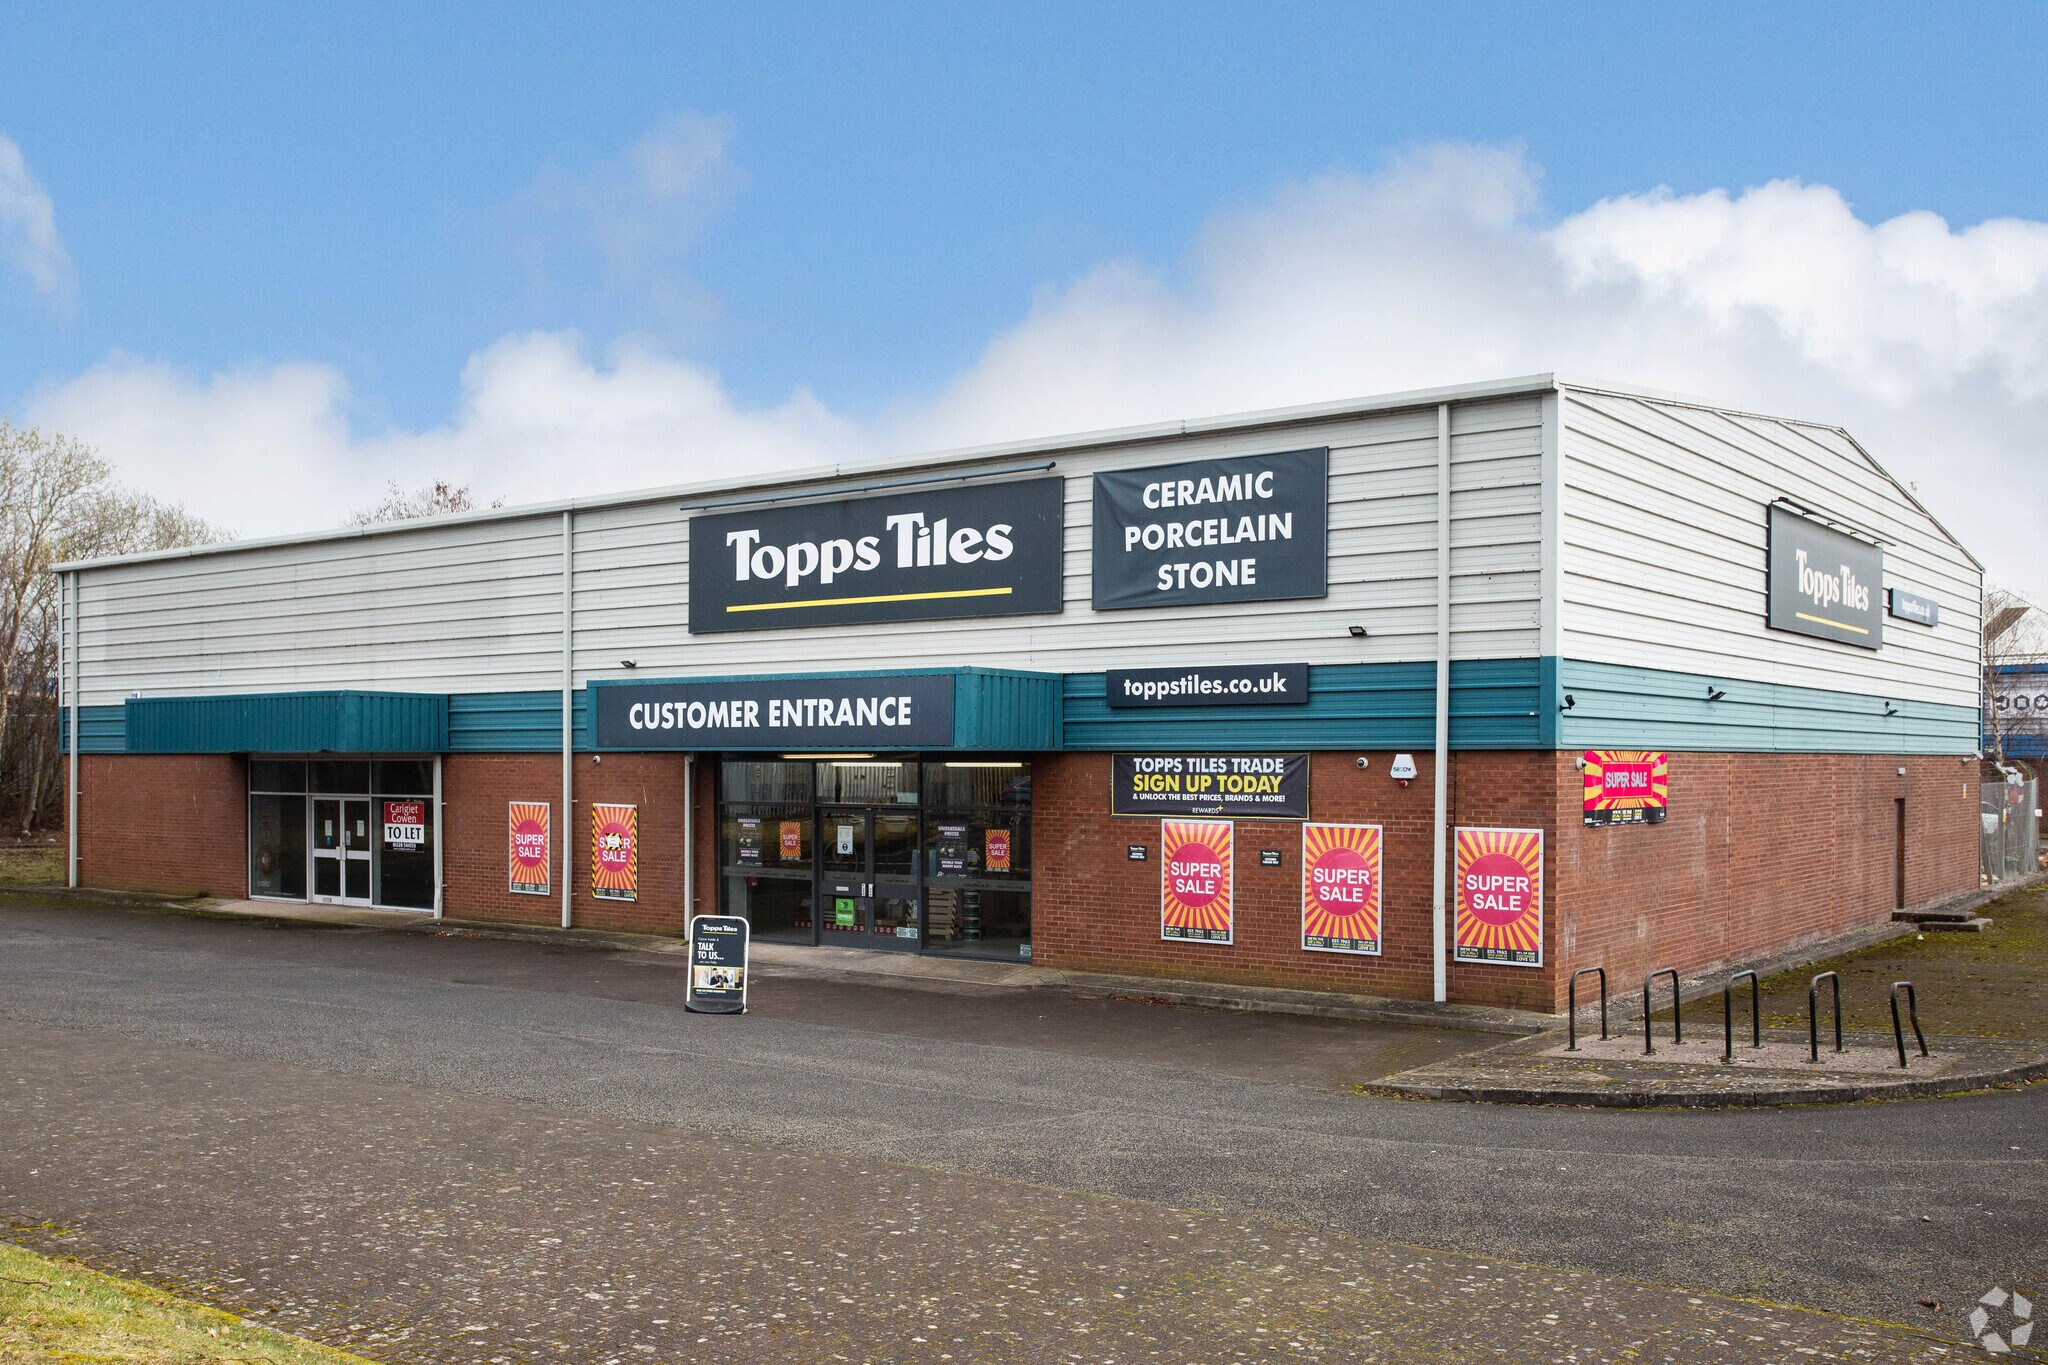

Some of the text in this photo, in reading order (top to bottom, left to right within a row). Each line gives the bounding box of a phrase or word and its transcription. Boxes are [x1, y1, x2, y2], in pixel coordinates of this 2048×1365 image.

[1142, 471, 1273, 509] CERAMIC
[1125, 512, 1292, 552] PORCELAIN
[726, 512, 1014, 587] Topps Tiles
[1157, 558, 1256, 591] STONE
[1796, 548, 1869, 611] Topps Tiles
[1124, 672, 1287, 700] toppstiles.co.uk
[629, 696, 912, 730] CUSTOMER ENTRANCE
[1133, 758, 1284, 773] TOPPS TILES TRADE
[1133, 775, 1283, 793] SIGN UP TODAY
[1606, 771, 1647, 788] SUPER SALE
[1139, 793, 1167, 801] UNLOCK
[1168, 793, 1181, 801] THE
[1199, 794, 1224, 802] PRICES,
[1225, 794, 1253, 802] BRANDS
[1262, 795, 1286, 803] MORE!
[390, 803, 418, 816] Carigiet
[391, 813, 417, 823] Cowen
[388, 826, 421, 840] TO LET
[515, 834, 545, 846] SUPER
[518, 846, 541, 858] SALE
[602, 850, 627, 863] SALE
[1170, 861, 1221, 878] SUPER
[1313, 867, 1370, 885] SUPER
[1175, 878, 1215, 894] SALE
[1466, 874, 1530, 893] SUPER
[1319, 885, 1364, 903] SALE
[1472, 893, 1522, 911] SALE
[698, 942, 714, 951] TALK
[698, 951, 707, 959] TO
